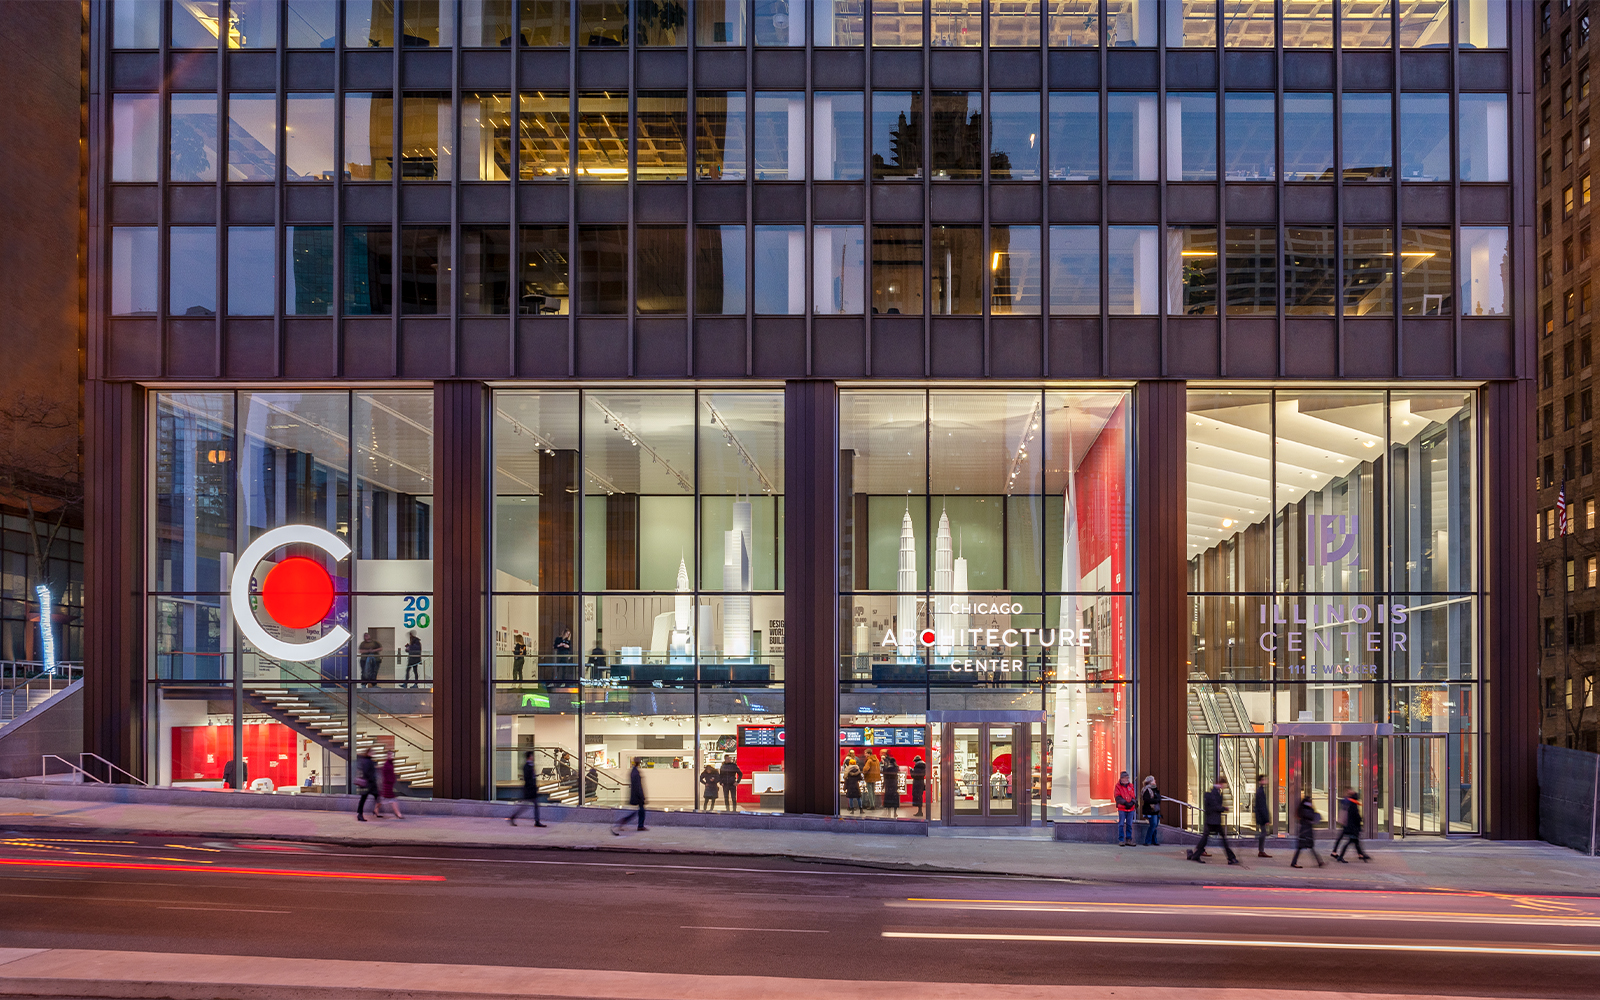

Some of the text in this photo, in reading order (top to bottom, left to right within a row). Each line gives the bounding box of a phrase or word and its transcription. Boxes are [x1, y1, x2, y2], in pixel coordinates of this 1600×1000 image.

[403, 595, 430, 611] 20
[950, 602, 1023, 615] CHICAGO
[403, 613, 430, 629] 50
[1260, 604, 1407, 624] ILLINOIS
[881, 628, 1092, 647] ARCHITECTURE
[1259, 632, 1407, 652] CENTER
[950, 659, 1023, 672] CENTER
[1288, 665, 1378, 675] 111 E WACKER
